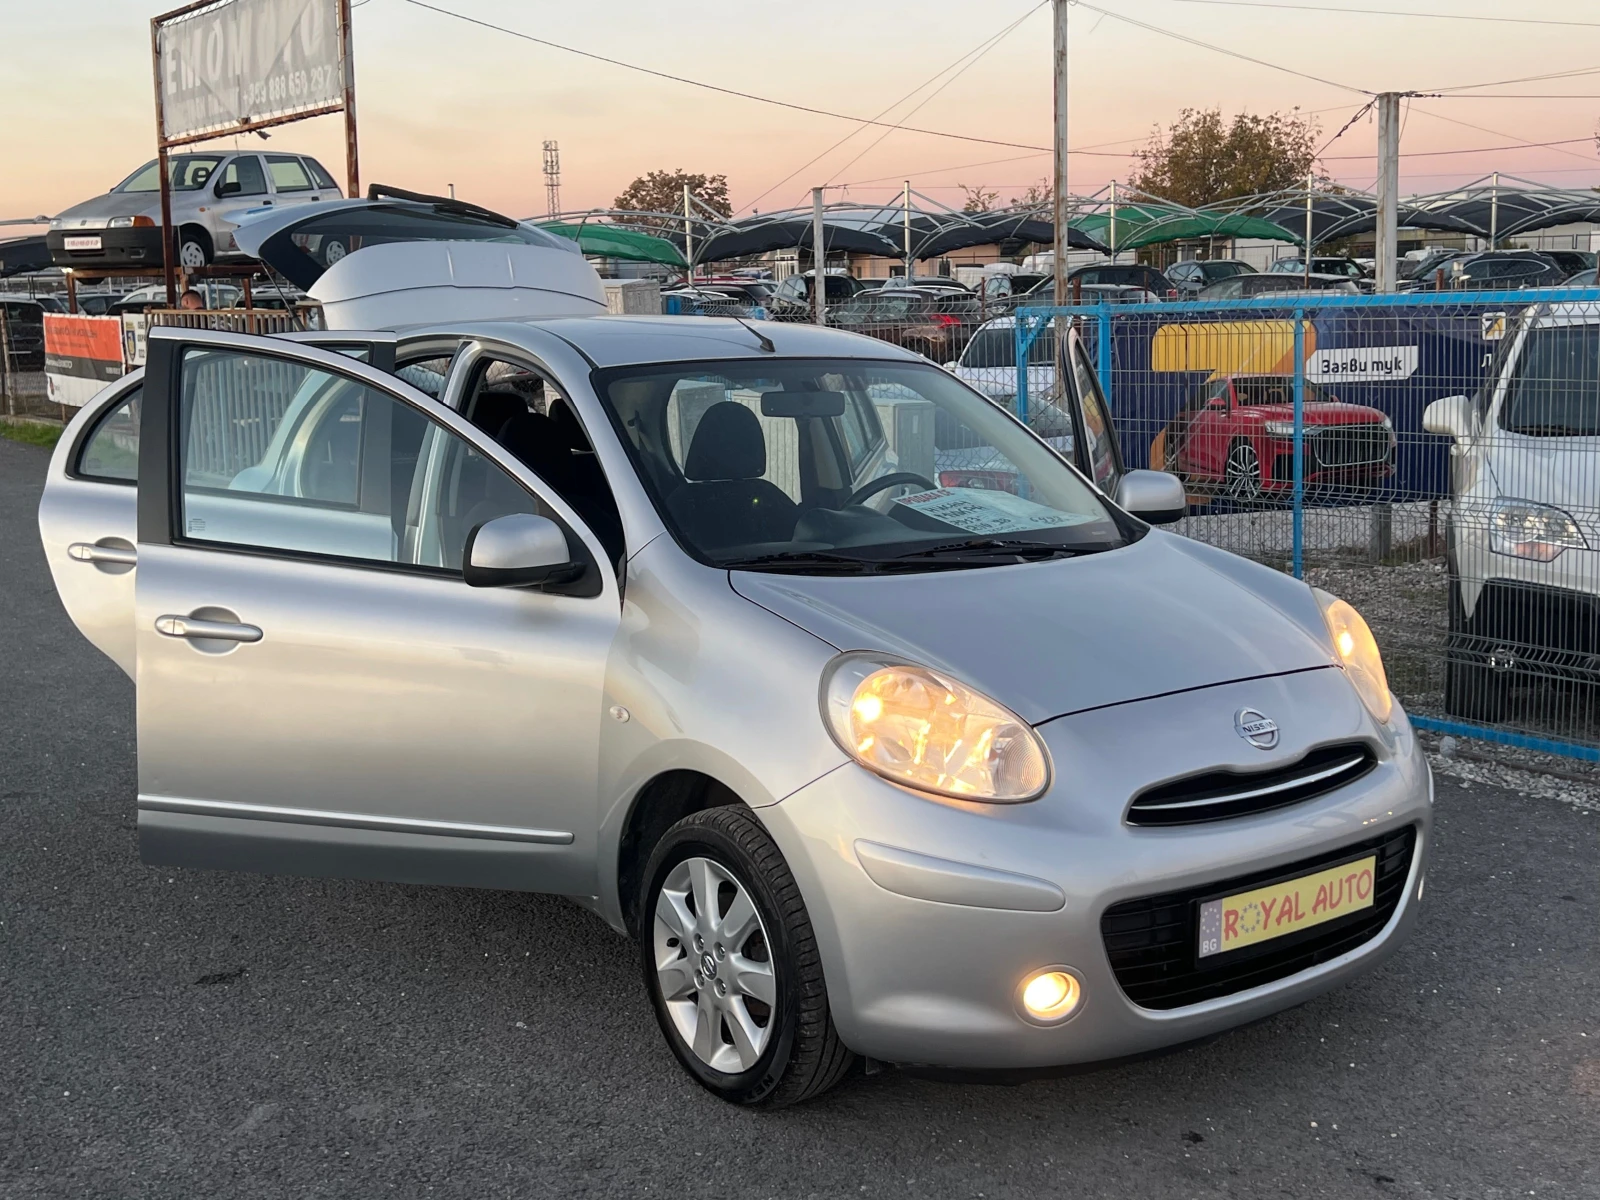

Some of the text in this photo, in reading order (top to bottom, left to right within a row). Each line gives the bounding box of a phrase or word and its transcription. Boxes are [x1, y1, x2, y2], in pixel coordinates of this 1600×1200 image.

[268, 75, 286, 101] 888
[310, 65, 332, 93] 297
[1321, 355, 1403, 374] Заяви тук
[1242, 721, 1277, 733] NISSAN
[1223, 868, 1373, 941] ROYAL AUTO
[1202, 938, 1217, 953] BG
